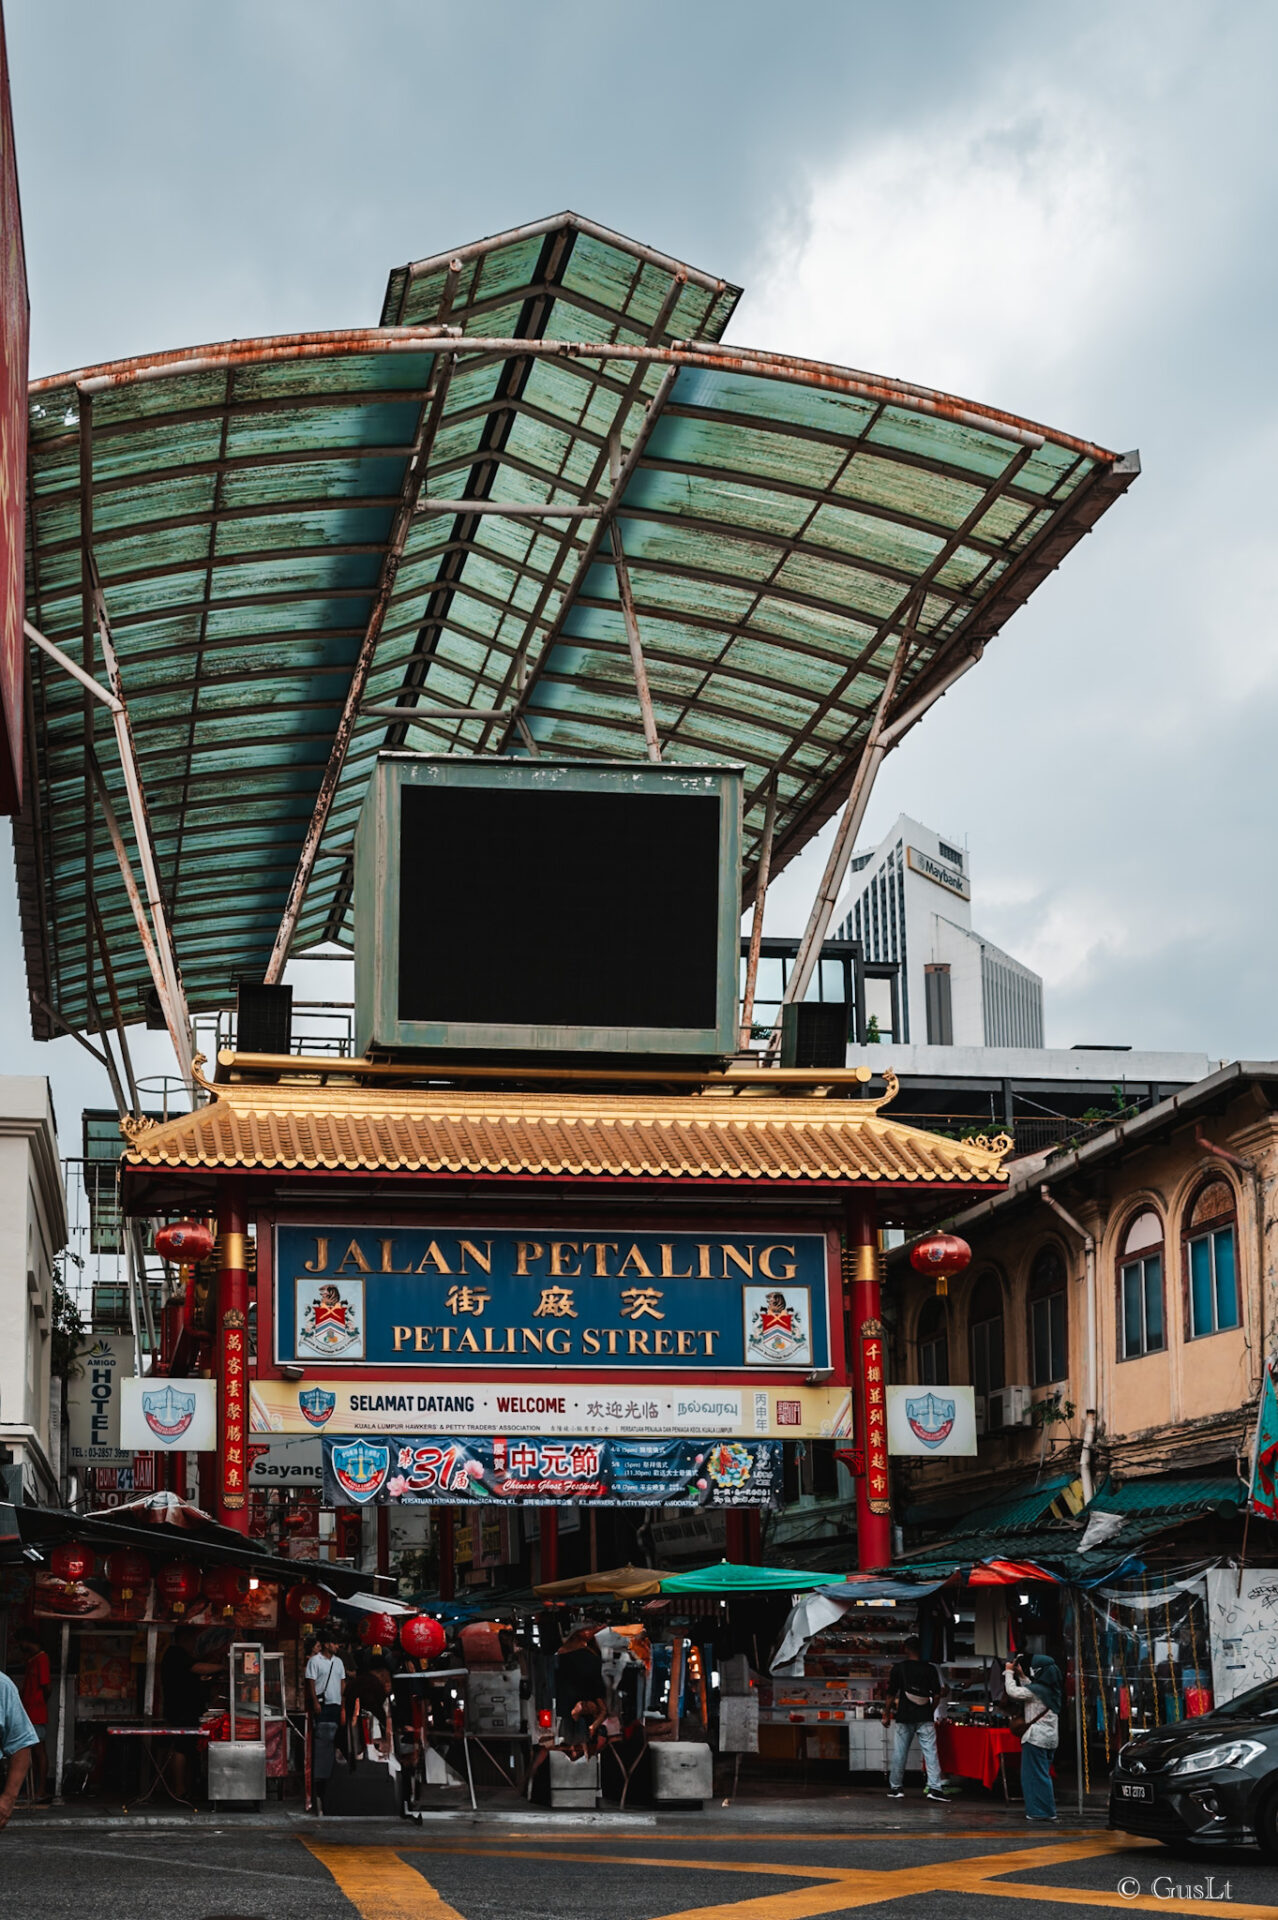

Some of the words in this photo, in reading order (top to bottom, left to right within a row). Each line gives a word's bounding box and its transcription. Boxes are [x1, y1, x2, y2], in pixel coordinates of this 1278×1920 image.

[925, 859, 963, 892] Maybank
[304, 1237, 495, 1276] JALAN
[512, 1241, 799, 1280] PETALING
[392, 1325, 573, 1355] PETALING
[581, 1328, 720, 1356] STREET
[91, 1369, 111, 1445] HOTEL
[350, 1395, 414, 1412] SELAMAT
[418, 1395, 474, 1413] DATANG
[497, 1397, 566, 1413] WELCOME
[586, 1400, 659, 1420] 欢迎光临
[755, 1393, 768, 1432] 丙申年
[71, 1447, 83, 1457] TEL
[511, 1443, 600, 1478] 中元節
[254, 1462, 323, 1479] Sayang
[502, 1479, 536, 1491] Chinese
[537, 1480, 562, 1492] Ghost
[562, 1480, 598, 1492] Festival
